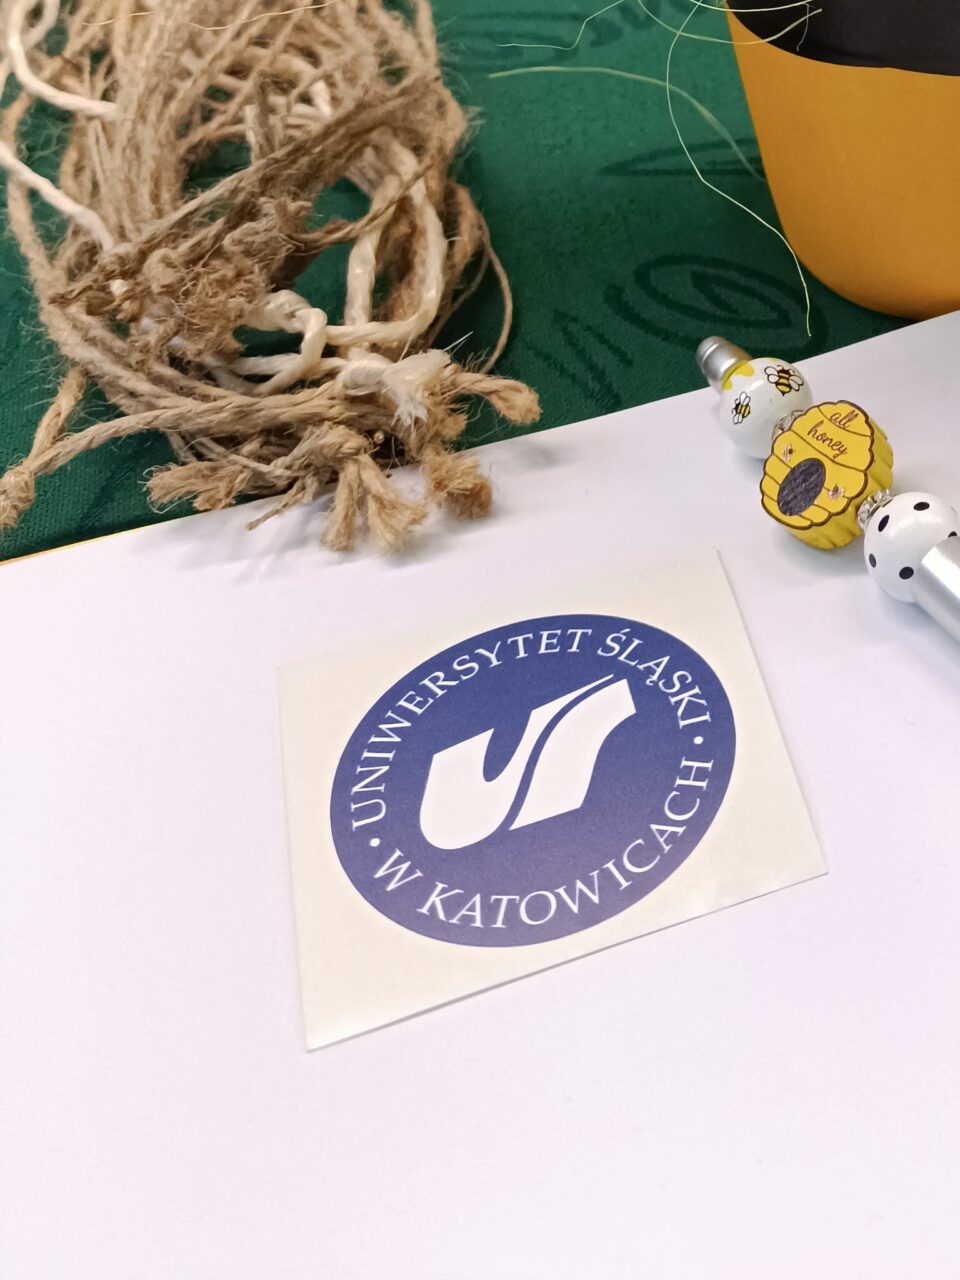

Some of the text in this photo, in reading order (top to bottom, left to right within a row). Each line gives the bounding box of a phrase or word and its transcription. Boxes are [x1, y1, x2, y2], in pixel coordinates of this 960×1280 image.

[807, 420, 848, 459] honey
[829, 409, 859, 429] all
[350, 628, 712, 831] UNIWERSYTET ŚLĄSKI
[373, 756, 715, 929] W KATOWICACH
